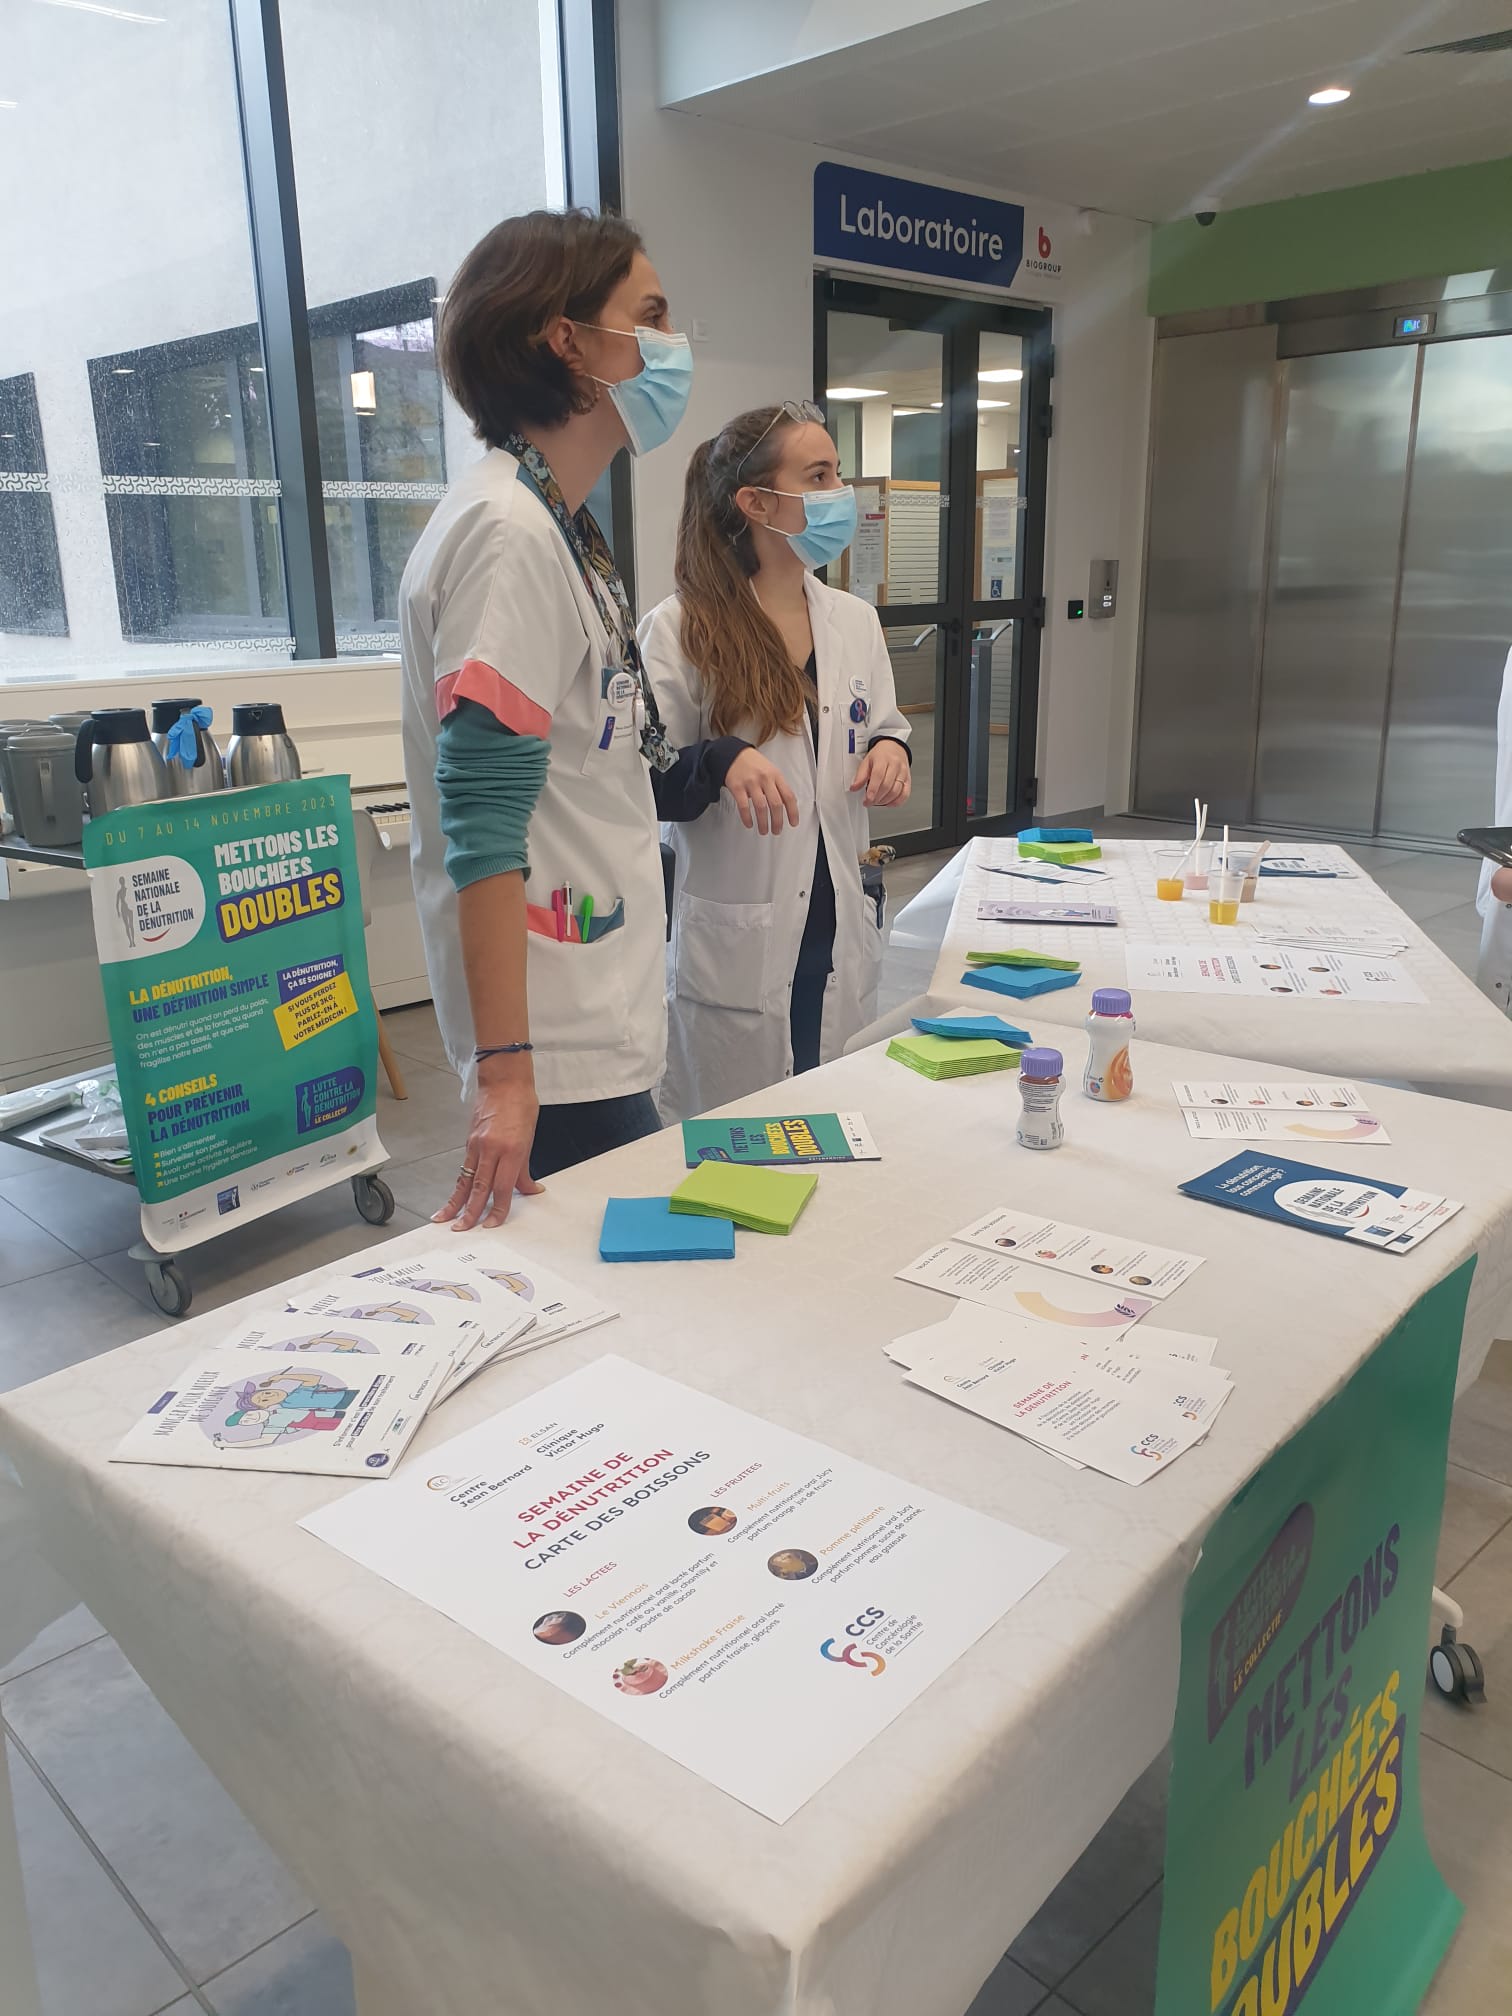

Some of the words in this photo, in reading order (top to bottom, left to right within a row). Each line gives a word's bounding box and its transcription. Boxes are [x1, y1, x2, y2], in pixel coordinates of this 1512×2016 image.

[840, 194, 1003, 261] Laboratoire
[105, 830, 126, 845] DU
[137, 826, 145, 839] 7
[155, 822, 173, 836] AU
[184, 817, 200, 830] 14
[210, 803, 291, 826] NOVEMBRE
[301, 795, 335, 811] 2023
[213, 831, 302, 867] METTONS
[305, 823, 339, 850] LES
[131, 867, 170, 887] SEMAINE
[217, 849, 312, 896] BOUCHÉES
[134, 881, 180, 902] NATIONALE
[136, 903, 149, 917] DE
[150, 900, 161, 913] LA
[220, 871, 341, 939] DOUBLES
[128, 986, 149, 1006] LA
[150, 963, 233, 1001] DÉNUTRITION,
[282, 971, 291, 980] LA
[287, 980, 298, 990] ÇA
[299, 977, 307, 985] SE
[307, 970, 332, 982] SOIGNE
[132, 1003, 160, 1024] UNE
[161, 983, 227, 1015] DÉFINITION
[229, 974, 269, 996] SIMPLE
[288, 1004, 294, 1013] SI
[294, 994, 313, 1008] VOUS
[313, 981, 336, 998] PERDEZ
[295, 1006, 310, 1019] PLUS
[311, 1001, 319, 1010] DE
[294, 1024, 315, 1040] VOTRE
[297, 1004, 332, 1028] PARLEZ-EN
[144, 1091, 156, 1108] 4
[158, 1072, 218, 1104] CONSEILS
[146, 1101, 182, 1126] POUR
[184, 1080, 243, 1113] PRÉVENIR
[149, 1125, 168, 1143] LA
[170, 1095, 250, 1136] DÉNUTRITION
[783, 1120, 821, 1156] DOUBLES
[1307, 1187, 1345, 1209] NATIONALE
[1012, 1385, 1047, 1409] SEMAINE
[1043, 1381, 1056, 1391] DE
[529, 1421, 559, 1438] ELSAN
[1014, 1409, 1027, 1418] LA
[534, 1428, 581, 1454] Clinique
[544, 1439, 578, 1458] Victor
[575, 1422, 607, 1440] Hugo
[1140, 1433, 1160, 1447] CCS
[448, 1480, 487, 1502] Centre
[458, 1490, 489, 1507] Jean
[487, 1464, 533, 1491] Bernard
[512, 1529, 545, 1549] LA
[538, 1447, 674, 1530] DÉNUTRITION
[515, 1468, 607, 1523] SEMAINE
[602, 1451, 634, 1469] DE
[709, 1486, 728, 1498] LES
[745, 1480, 791, 1511] Multi-fruits
[521, 1529, 588, 1571] CARTE
[583, 1505, 625, 1531] DES
[621, 1450, 712, 1507] BOISSONS
[725, 1512, 772, 1544] Complément
[766, 1487, 807, 1514] nutritionnel
[802, 1478, 819, 1488] oral
[744, 1520, 775, 1541] parfum
[818, 1531, 852, 1555] Pomme
[810, 1551, 856, 1585] Complément
[849, 1524, 888, 1552] nutritionnel
[883, 1514, 900, 1526] oral
[828, 1562, 857, 1583] parfum
[876, 1528, 898, 1543] sucre
[892, 1521, 906, 1530] de
[867, 1552, 884, 1564] eau
[561, 1623, 614, 1660] Complément
[611, 1593, 656, 1625] nutritionnel
[652, 1582, 672, 1596] oral
[668, 1570, 690, 1585] lacté
[686, 1552, 717, 1572] parfum
[562, 1584, 583, 1597] LES
[594, 1608, 611, 1619] Le
[607, 1581, 649, 1610] Viennois
[589, 1625, 628, 1653] chocolat,
[624, 1613, 646, 1627] café
[642, 1606, 656, 1615] ou
[677, 1565, 712, 1589] chantilly
[634, 1611, 665, 1633] poudre
[660, 1603, 675, 1613] de
[672, 1587, 697, 1605] cacao
[841, 1605, 887, 1638] CCS
[669, 1633, 719, 1670] Milkshake
[713, 1612, 747, 1636] Fraise
[865, 1625, 890, 1645] Centre
[886, 1618, 899, 1627] de
[873, 1613, 919, 1650] Cancérologie
[883, 1644, 897, 1654] de
[891, 1638, 903, 1646] la
[899, 1620, 924, 1640] Sarthe
[1244, 1608, 1284, 1675] COLLECTIF
[657, 1659, 711, 1700] Complément
[706, 1626, 754, 1661] nutritionnel
[748, 1615, 768, 1629] oral
[763, 1601, 786, 1617] lacté
[696, 1658, 731, 1683] parfum
[725, 1639, 754, 1660] fraise,
[749, 1618, 782, 1642] glaçons
[1244, 1522, 1400, 1790] METTONS
[1289, 1665, 1352, 1803] LES
[1211, 1671, 1400, 2013] BOUCHÉES
